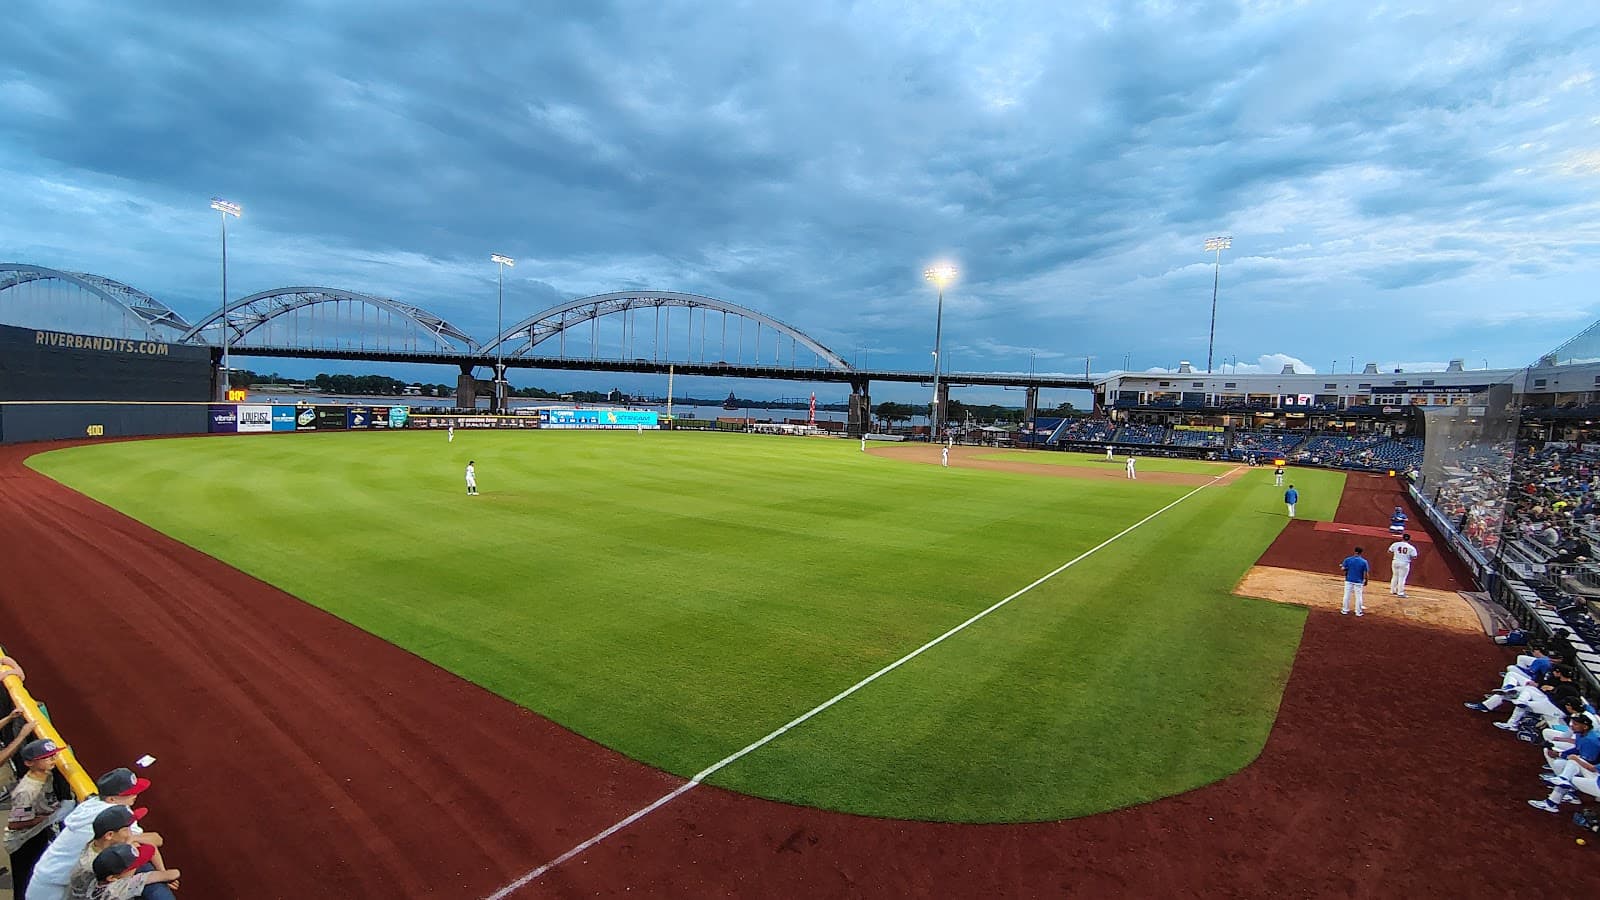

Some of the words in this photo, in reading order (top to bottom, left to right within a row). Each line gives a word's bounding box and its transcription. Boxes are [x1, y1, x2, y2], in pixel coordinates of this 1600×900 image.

[35, 331, 169, 355] RIVERBANDITS.COM
[87, 425, 103, 435] 400
[1397, 546, 1408, 554] 40
